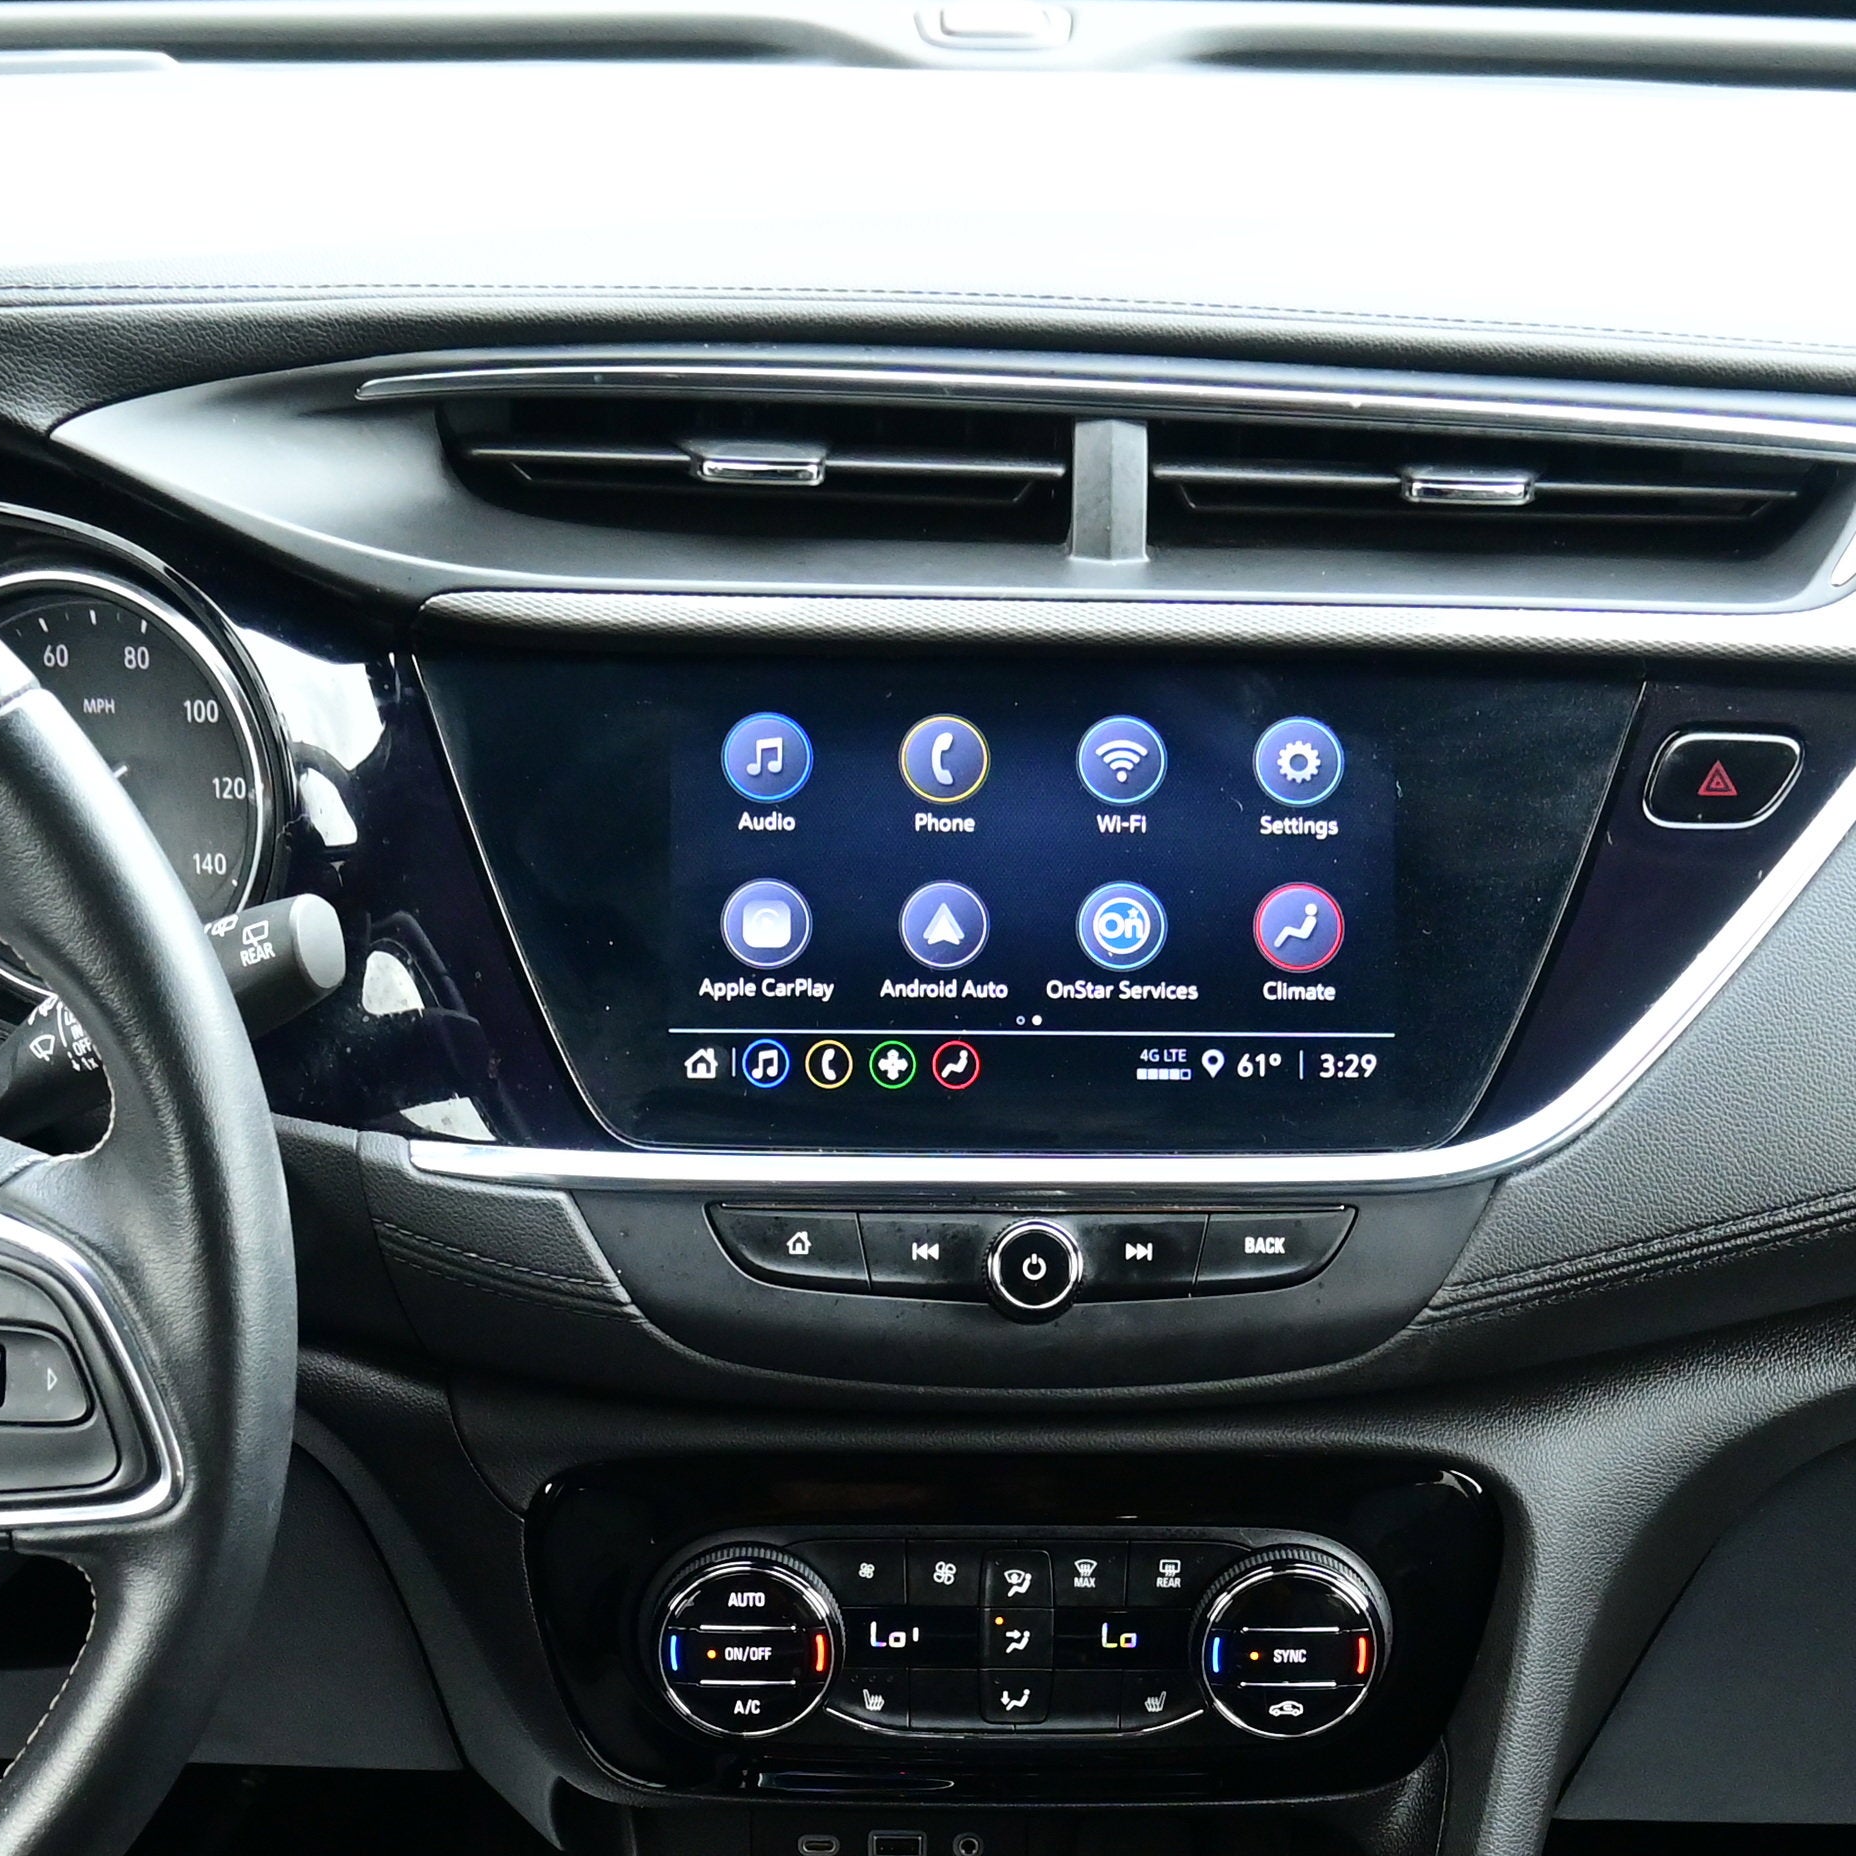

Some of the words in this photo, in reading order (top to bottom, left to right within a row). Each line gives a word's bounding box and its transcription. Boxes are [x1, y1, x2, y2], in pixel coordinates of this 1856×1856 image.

[44, 644, 69, 668] 60
[124, 646, 150, 670] 80
[83, 698, 115, 714] MPH
[183, 700, 219, 723] 100
[212, 777, 246, 799] 120
[738, 812, 795, 832] Audio
[914, 813, 976, 834] Phone
[1096, 813, 1147, 835] Wi-Fi
[1260, 815, 1339, 840] Settings
[193, 853, 227, 875] 140
[240, 942, 276, 967] REAR
[699, 977, 756, 1001] Apple
[765, 977, 834, 1001] CarPlay
[880, 977, 956, 1000] Android
[961, 978, 1008, 1000] Auto
[1046, 980, 1112, 1000] OnStar
[1120, 980, 1199, 1001] Services
[1262, 980, 1337, 1002] Climate
[1140, 1049, 1159, 1062] 4G
[1164, 1049, 1187, 1062] LTE
[1319, 1053, 1377, 1078] 3:29
[1244, 1236, 1285, 1256] BACK
[1074, 1576, 1096, 1588] MAX
[1156, 1576, 1181, 1588] REAR
[728, 1592, 766, 1608] AUTO
[724, 1647, 772, 1662] ON/OFF
[1273, 1649, 1307, 1664] SYNC
[733, 1700, 761, 1716] A/C
